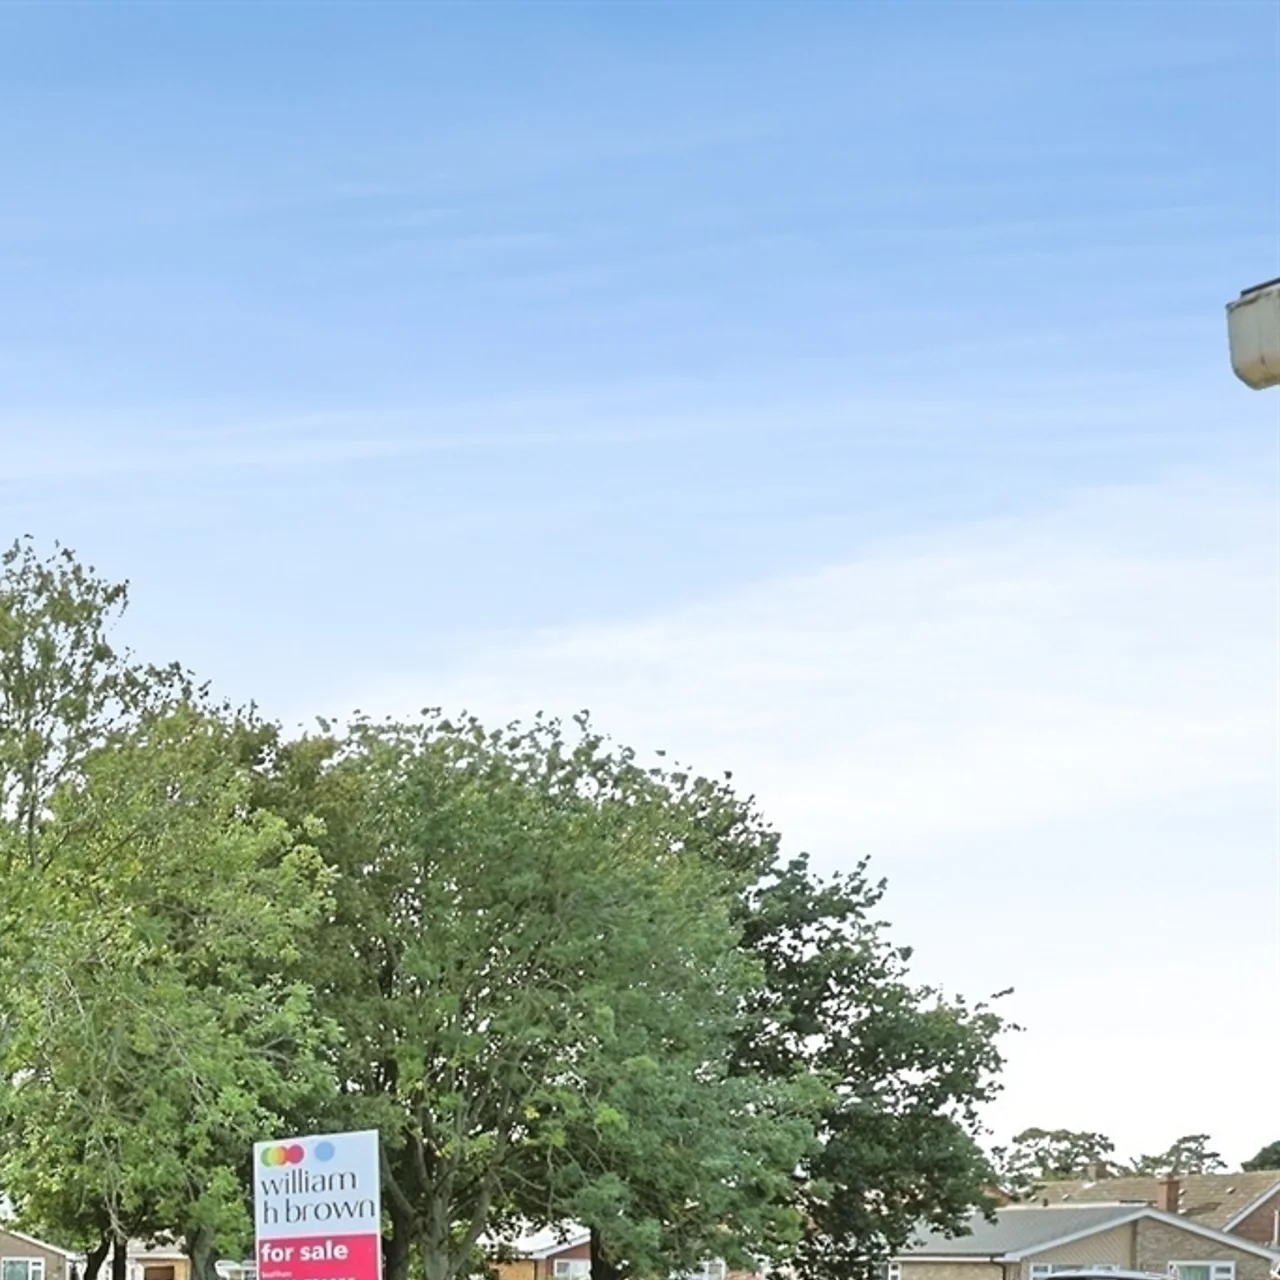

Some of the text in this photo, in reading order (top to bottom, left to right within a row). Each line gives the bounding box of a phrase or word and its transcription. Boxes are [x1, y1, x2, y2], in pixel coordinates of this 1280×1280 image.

[261, 1168, 357, 1196] william
[263, 1199, 375, 1224] h brown
[261, 1240, 348, 1262] for sale
